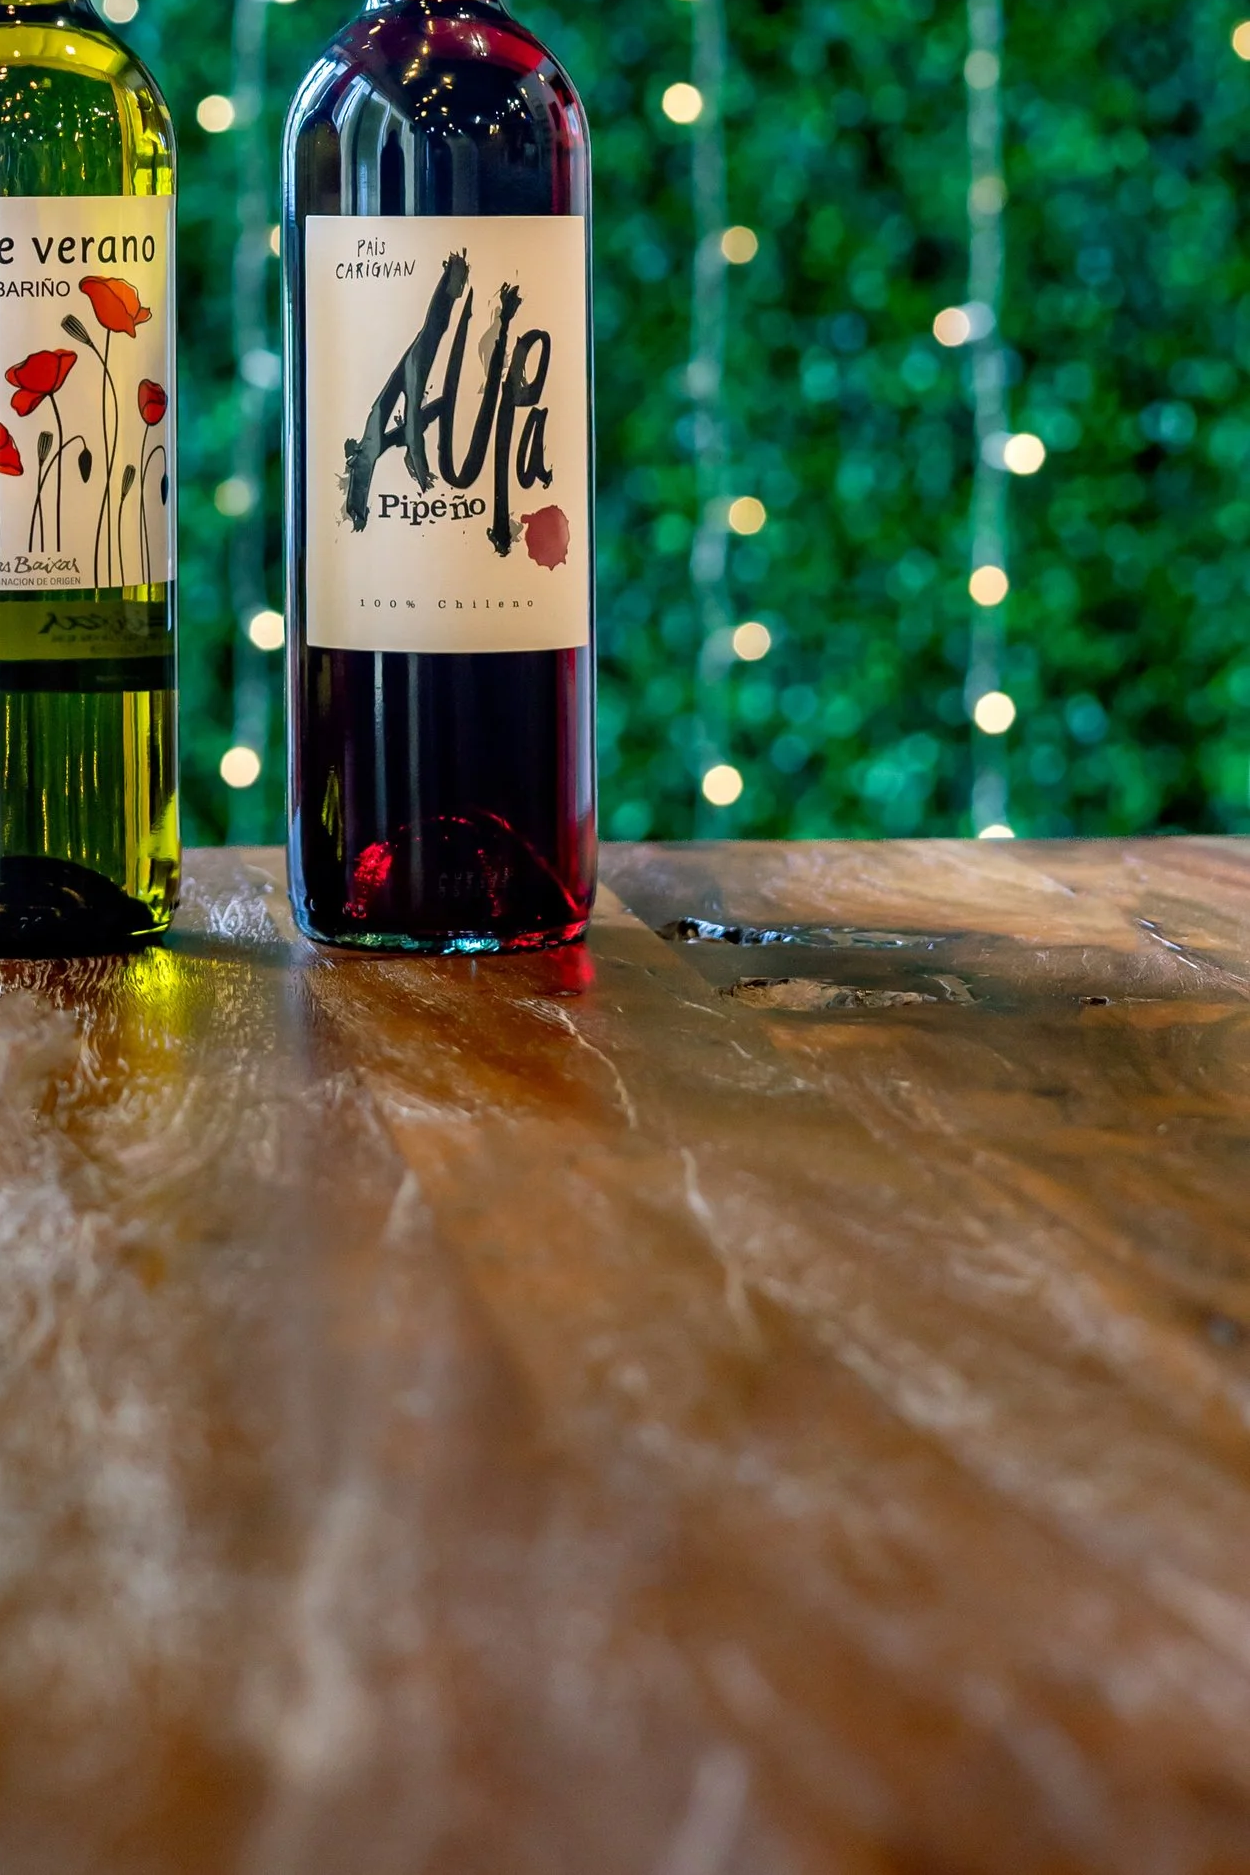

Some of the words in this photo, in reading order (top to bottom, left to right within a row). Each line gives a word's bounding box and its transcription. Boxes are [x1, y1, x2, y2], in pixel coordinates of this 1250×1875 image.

[32, 234, 155, 264] verano
[36, 577, 48, 585] DE
[50, 576, 81, 584] ORIGEN
[438, 599, 533, 609] Chileno
